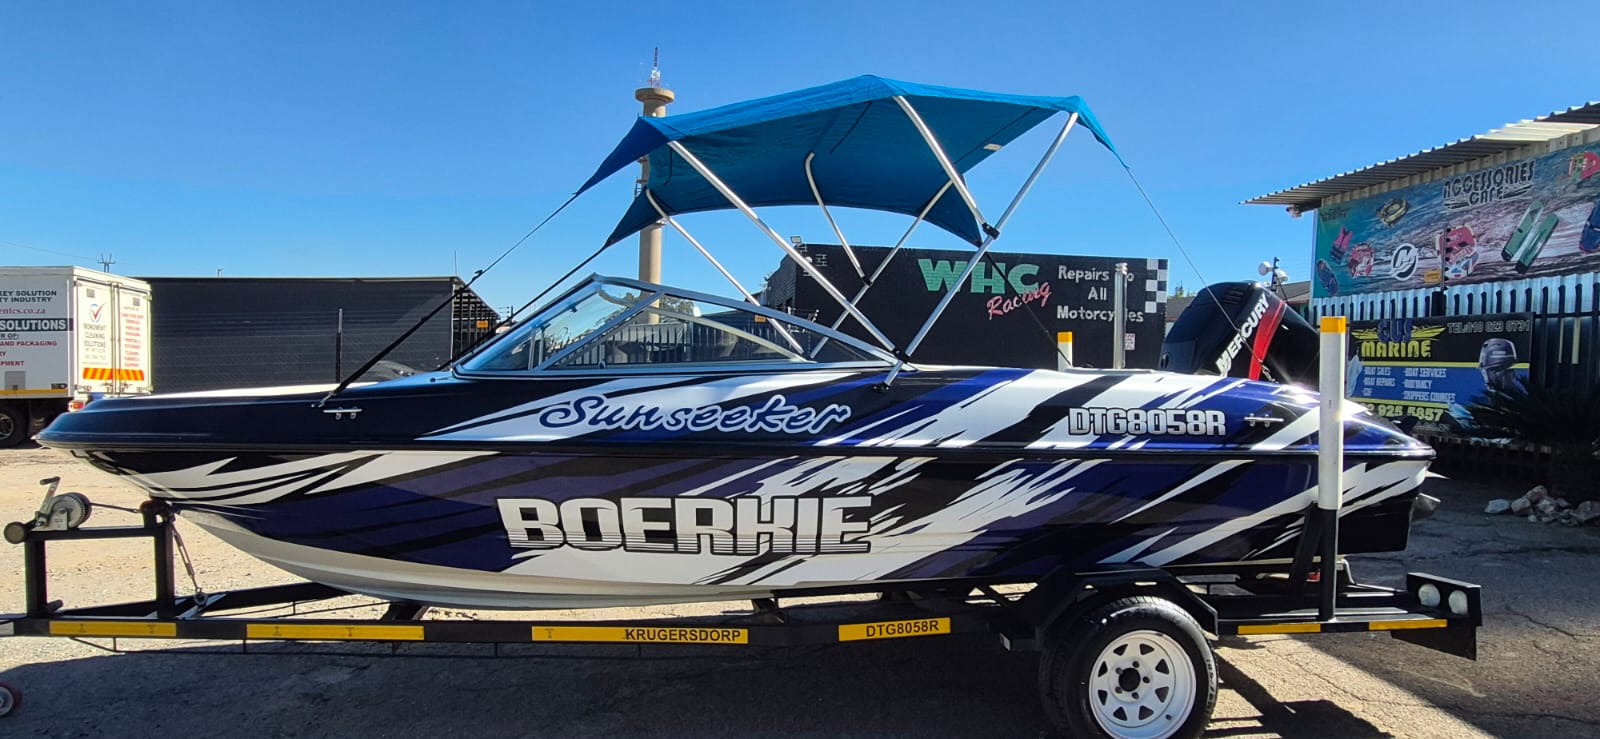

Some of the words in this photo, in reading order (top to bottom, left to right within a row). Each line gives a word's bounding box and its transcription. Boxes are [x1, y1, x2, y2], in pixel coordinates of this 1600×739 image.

[1443, 160, 1535, 199] ACCESSORIES
[917, 258, 1040, 294] WHC
[1058, 265, 1110, 284] Repairs
[987, 281, 1052, 320] Racing
[1087, 286, 1107, 301] All
[1057, 305, 1144, 322] Motorcyes
[0, 319, 67, 331] SOLUTIONS
[1216, 291, 1269, 378] MERCURY
[1361, 340, 1431, 358] MARINE
[1419, 368, 1447, 378] SERVICES
[539, 395, 851, 433] Sunseeker
[1378, 404, 1403, 417] 925
[1068, 407, 1226, 436] DTG8058R
[625, 628, 741, 642] KRUGERSDORP
[866, 621, 940, 638] DTG8058R
